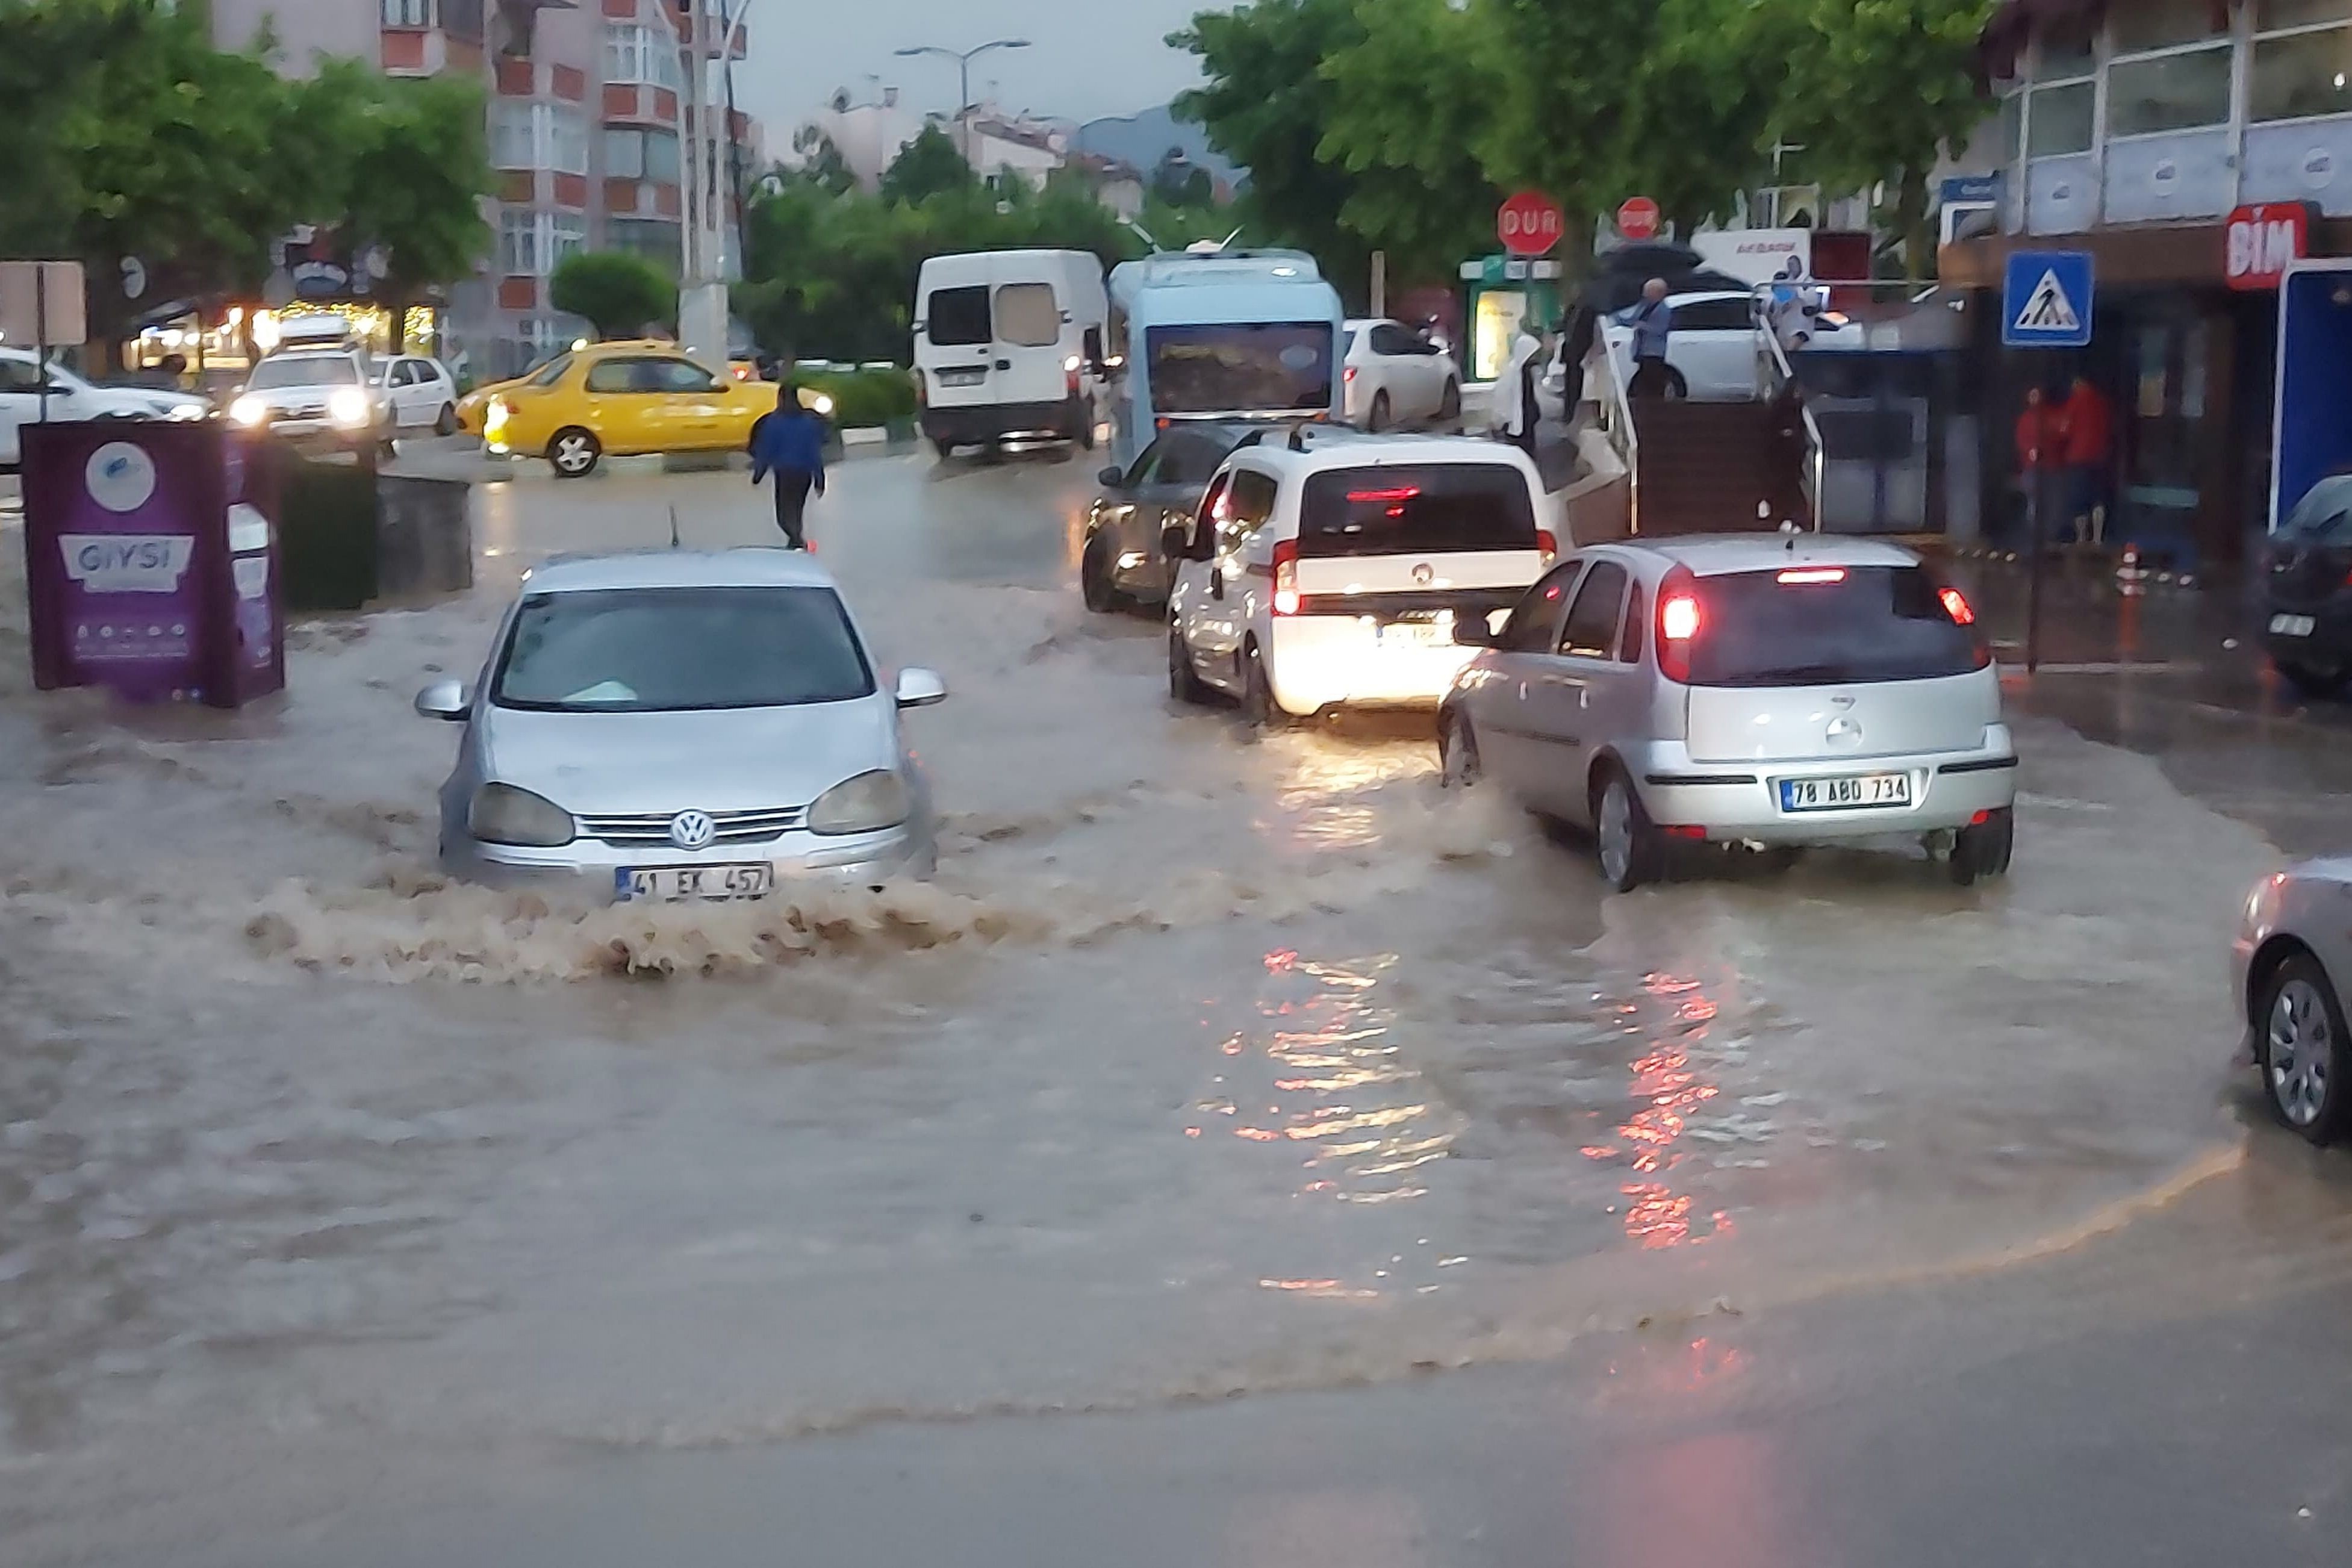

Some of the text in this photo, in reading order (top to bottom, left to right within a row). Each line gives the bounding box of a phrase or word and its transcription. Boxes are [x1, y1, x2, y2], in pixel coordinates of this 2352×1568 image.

[1505, 210, 1557, 235] DUR
[1794, 783, 1817, 803] 78
[1872, 778, 1905, 798] 734
[634, 873, 657, 894] 41
[725, 868, 764, 891] 457
